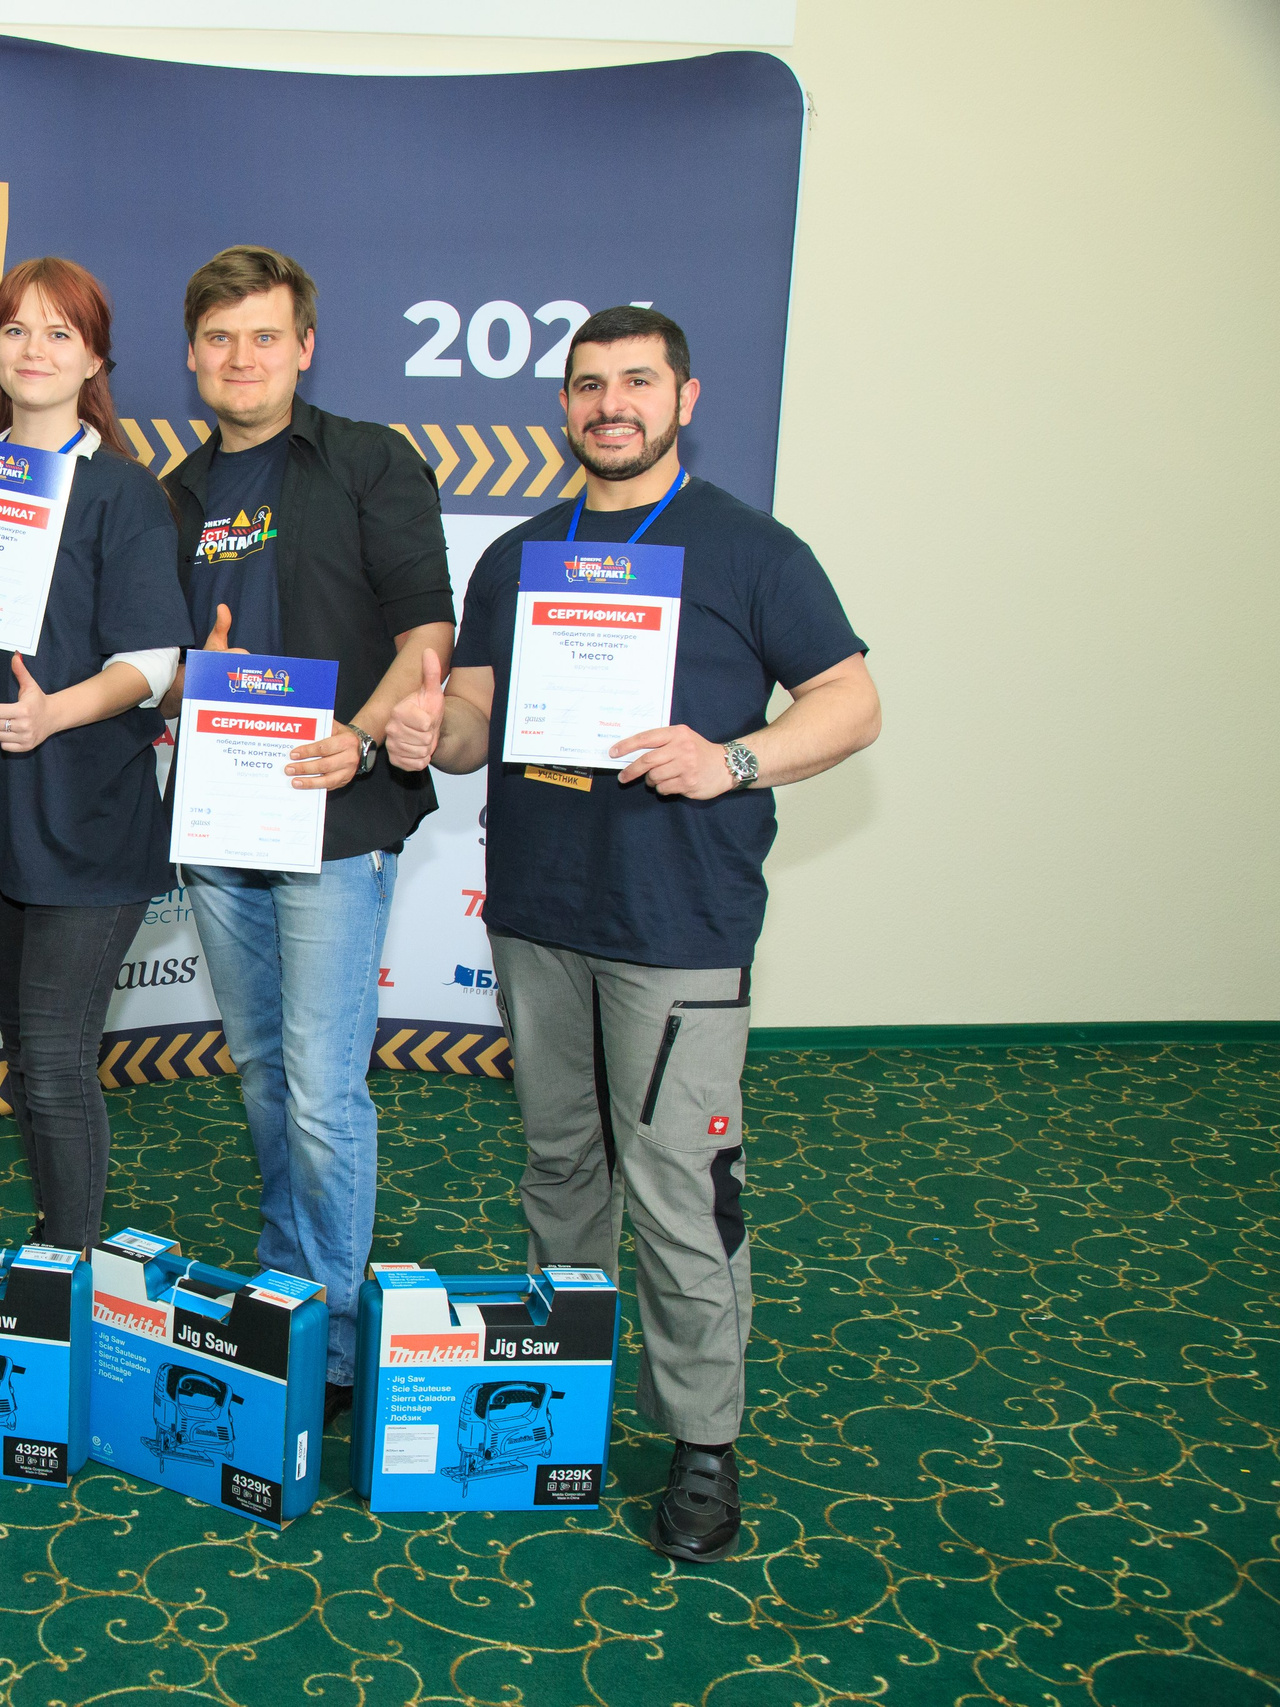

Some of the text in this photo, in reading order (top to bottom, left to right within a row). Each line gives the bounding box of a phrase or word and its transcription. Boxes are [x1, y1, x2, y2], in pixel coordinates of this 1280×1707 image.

[403, 300, 653, 379] 202
[204, 518, 231, 528] ОНКУРС
[548, 609, 645, 622] СЕРТИФИКАТ
[571, 651, 613, 661] 1 место
[212, 718, 301, 733] СЕРТИФИКАТ
[525, 716, 545, 724] gauss
[241, 760, 273, 769] место
[538, 770, 578, 785] УЧАСТНИК
[114, 956, 199, 990] auss
[99, 1332, 125, 1346] Jig Saw
[99, 1341, 112, 1350] Scie
[178, 1324, 200, 1348] Jig
[205, 1332, 238, 1357] Saw
[490, 1339, 517, 1358] Jig
[521, 1338, 559, 1355] Saw
[392, 1375, 425, 1384] Jig Saw
[390, 1405, 432, 1413] Stichsäge
[16, 1443, 58, 1458] 4329K
[549, 1469, 592, 1480] 4329K
[233, 1474, 271, 1496] 4329K
